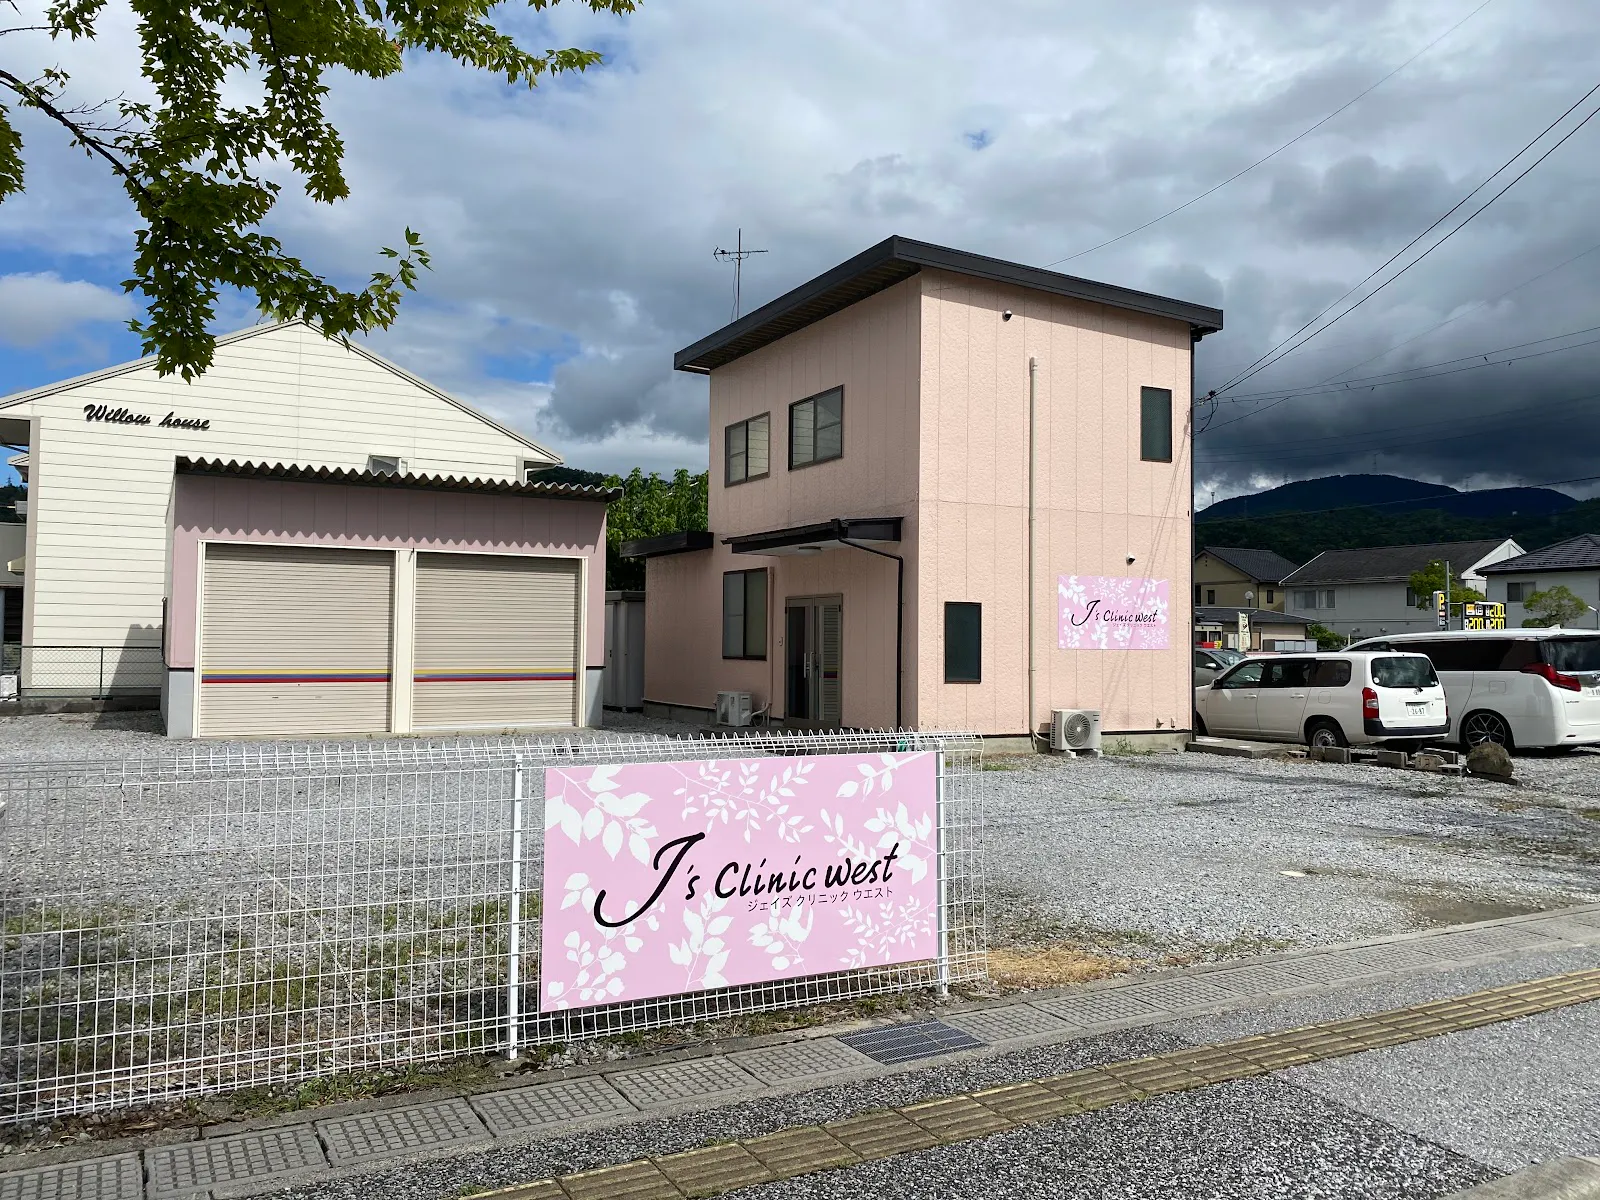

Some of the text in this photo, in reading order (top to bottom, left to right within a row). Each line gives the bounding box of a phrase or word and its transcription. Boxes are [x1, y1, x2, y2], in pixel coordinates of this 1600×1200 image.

[84, 404, 211, 431] Willow house
[1071, 600, 1158, 626] J's Clinic west
[594, 832, 899, 928] J's Clinic west
[748, 886, 893, 912] ジェイズ クリニック ウエスト
